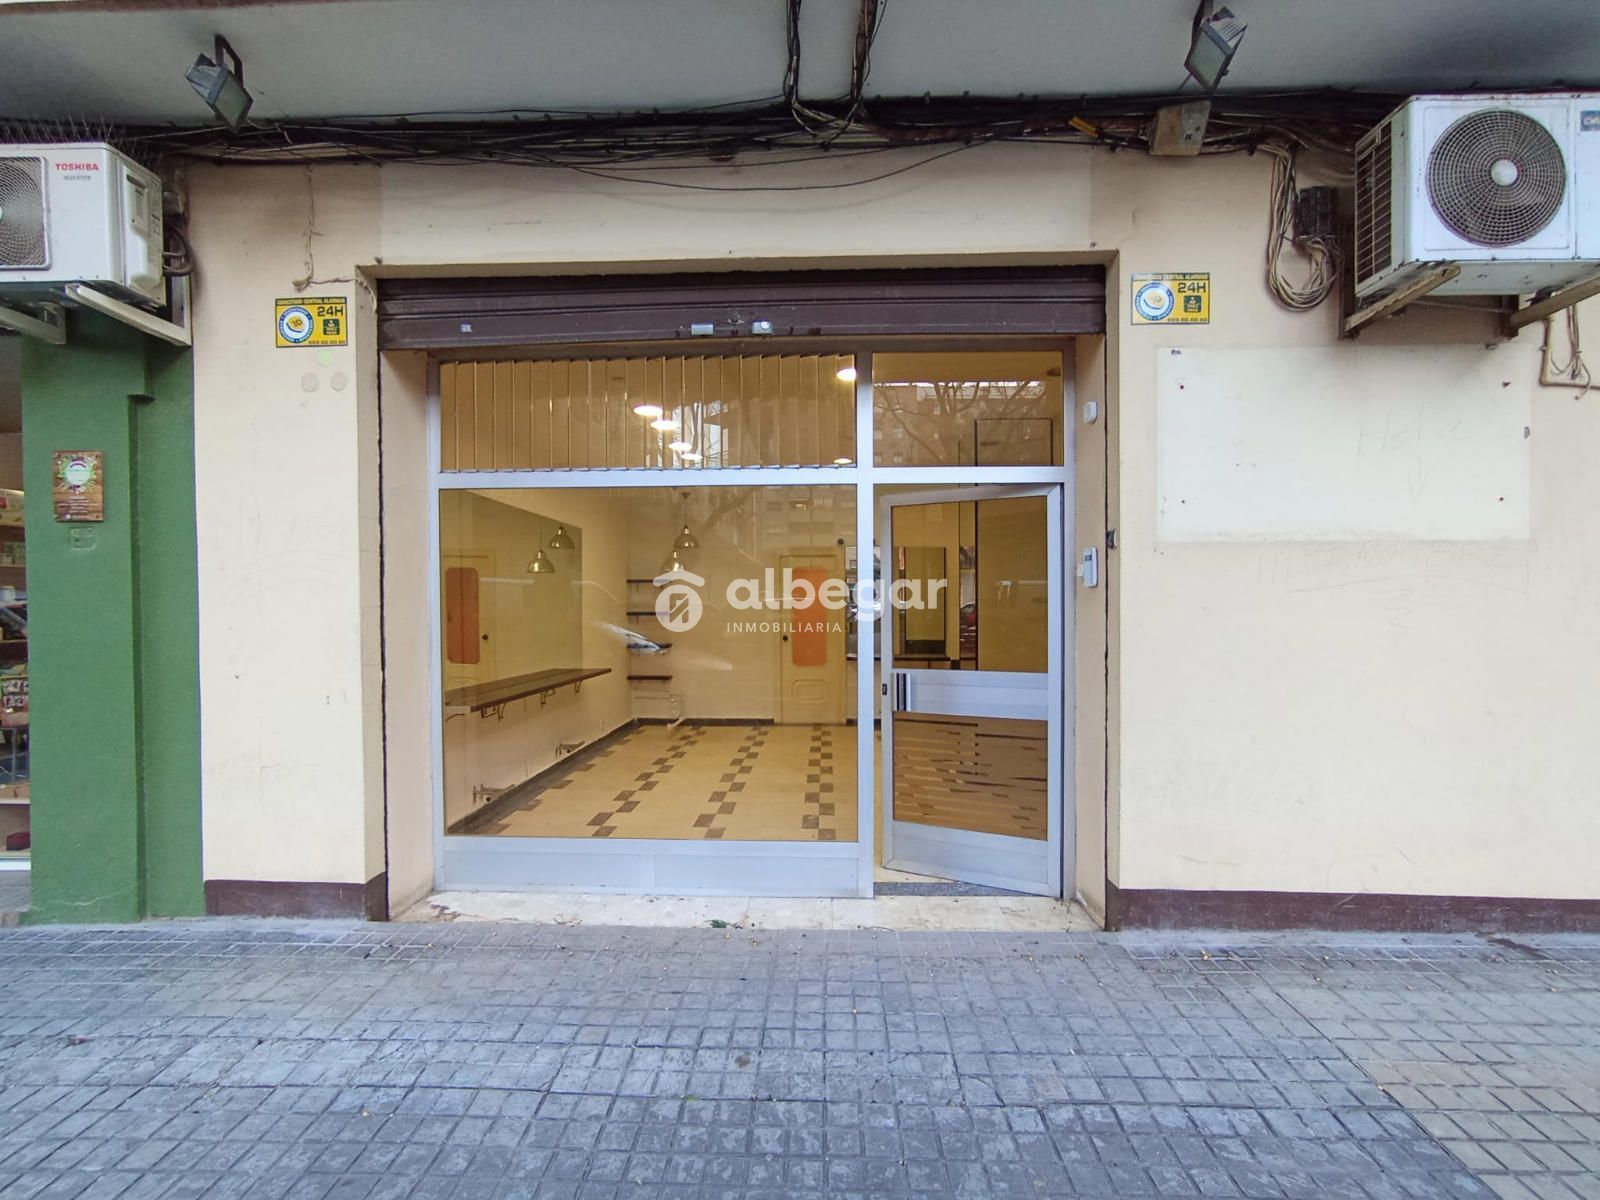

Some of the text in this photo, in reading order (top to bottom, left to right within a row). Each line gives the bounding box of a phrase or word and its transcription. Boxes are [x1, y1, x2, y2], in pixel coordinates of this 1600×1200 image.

[55, 163, 100, 171] TOSHIBA
[1177, 282, 1206, 293] 24H
[317, 305, 344, 317] 24H
